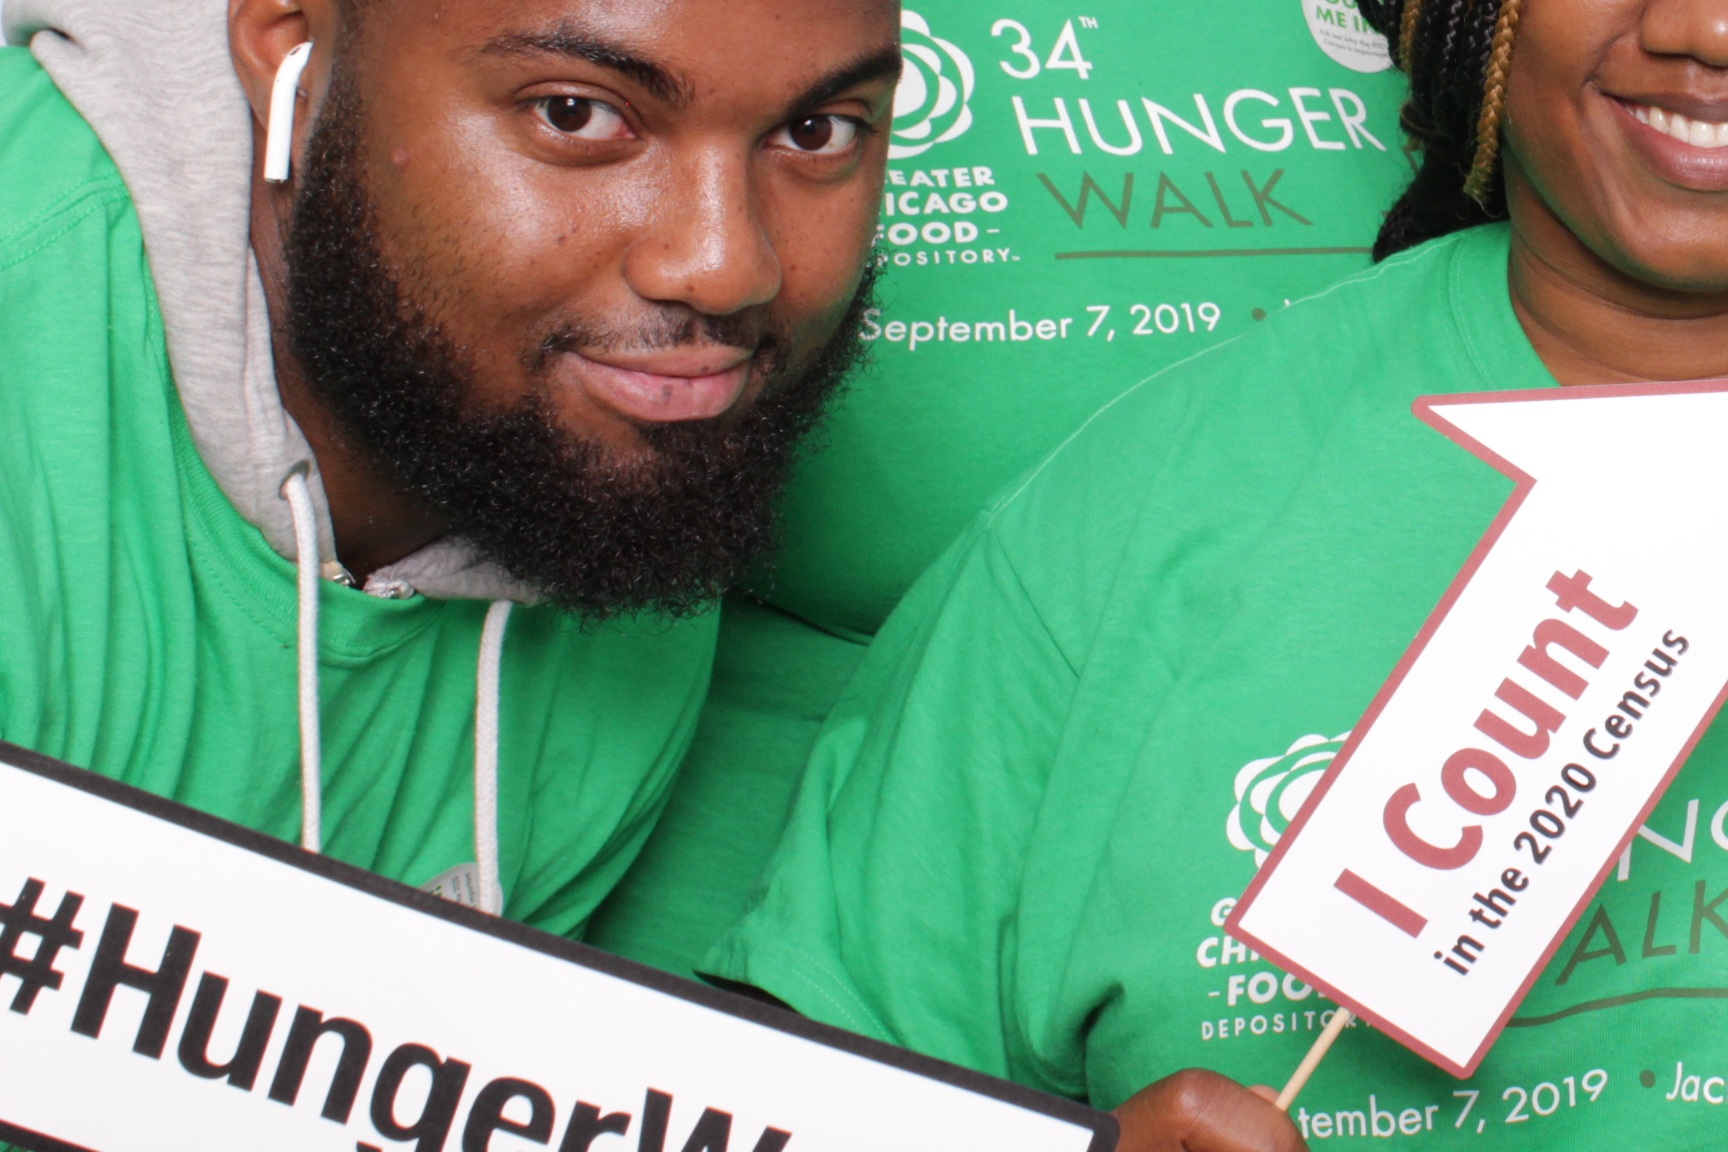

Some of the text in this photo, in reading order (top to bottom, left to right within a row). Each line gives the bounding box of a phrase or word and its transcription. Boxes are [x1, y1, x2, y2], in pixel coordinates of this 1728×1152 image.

[1316, 4, 1347, 29] ME
[1011, 86, 1387, 156] HUNGER
[885, 166, 995, 188] EATER
[1036, 169, 1314, 230] WALK
[884, 191, 1008, 216] ICAGO
[857, 301, 1222, 351] September 7, 2019
[1333, 568, 1640, 939] I Count
[1433, 628, 1690, 976] in the 2020 Census
[1227, 971, 1327, 1006] FOO
[1201, 1008, 1372, 1040] DEPOSITOR
[1298, 1068, 1608, 1140] tember 7, 2019
